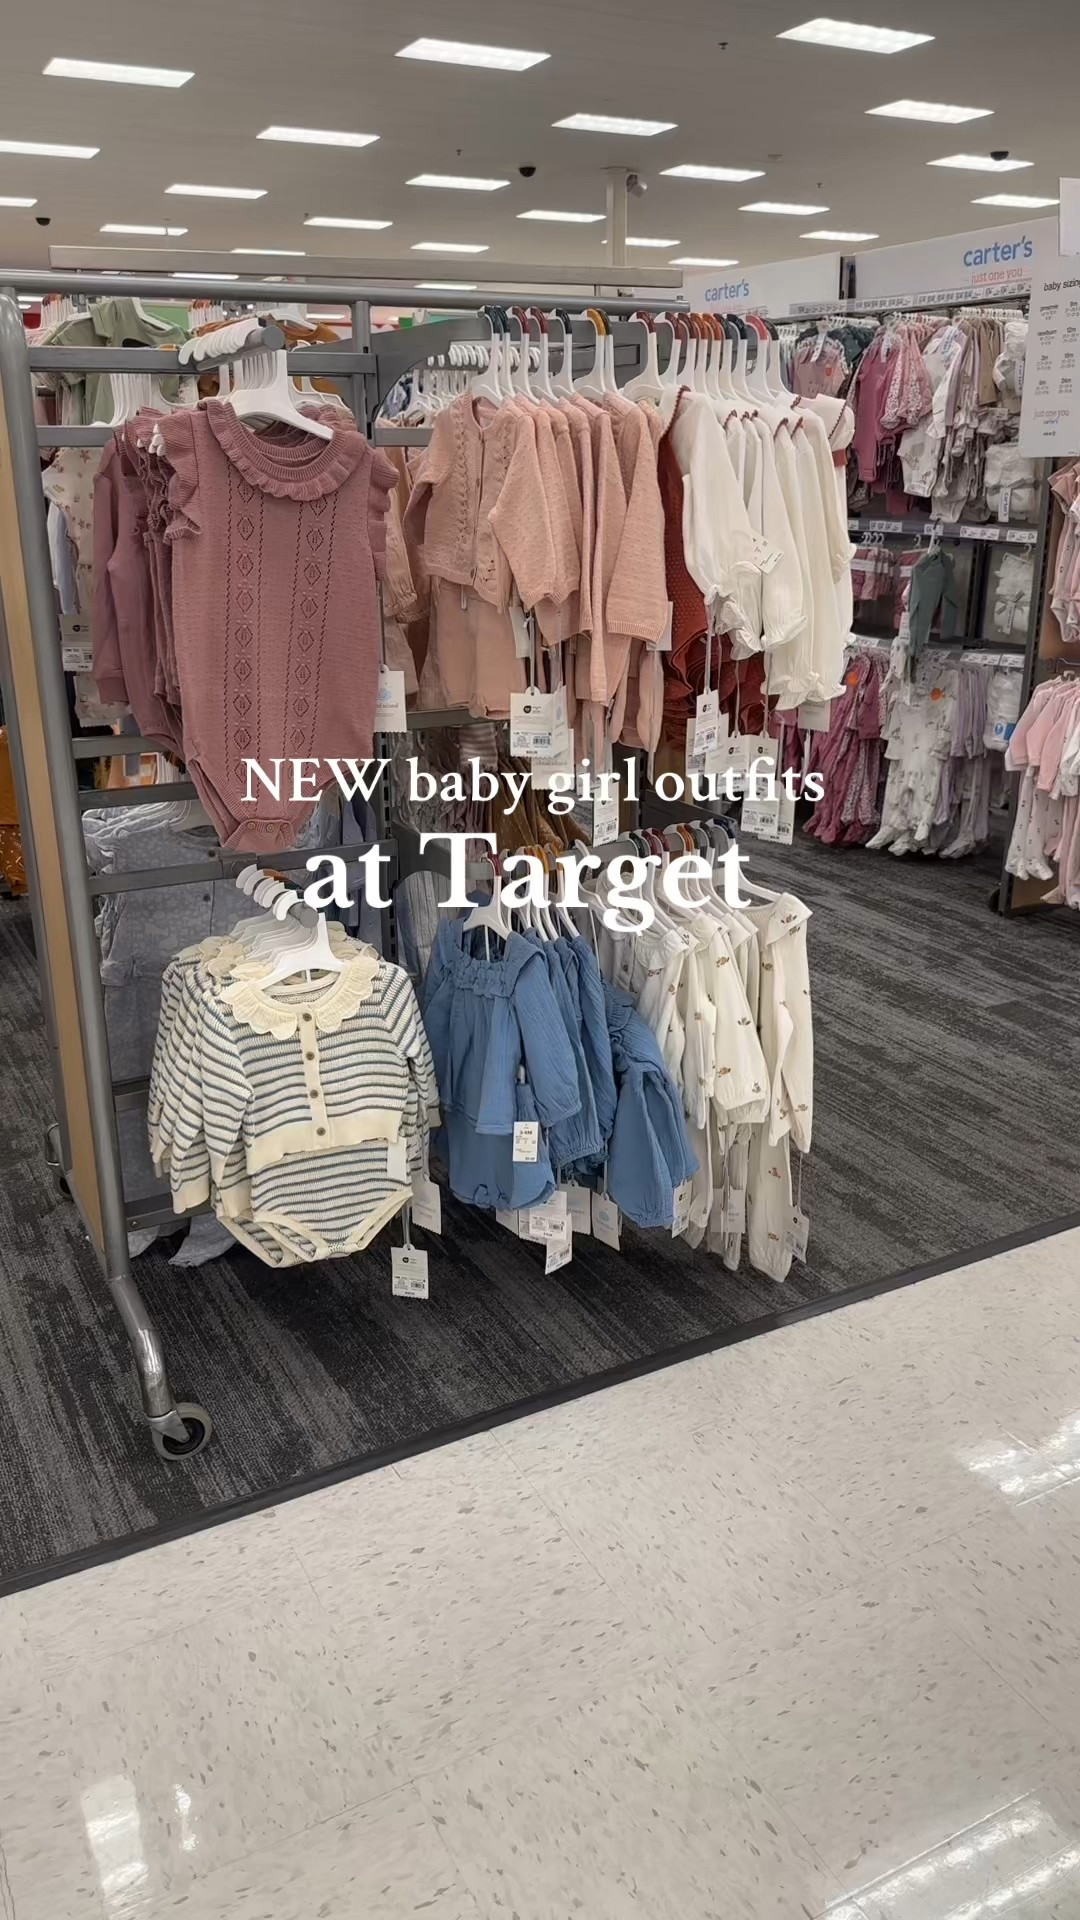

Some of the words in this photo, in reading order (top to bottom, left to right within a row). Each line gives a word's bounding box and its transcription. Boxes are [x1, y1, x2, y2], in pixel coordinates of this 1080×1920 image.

[963, 235, 1033, 267] carter's
[971, 271, 987, 286] just
[988, 271, 1005, 282] one
[1006, 267, 1023, 280] you
[1043, 281, 1062, 292] baby
[704, 278, 750, 302] carter's
